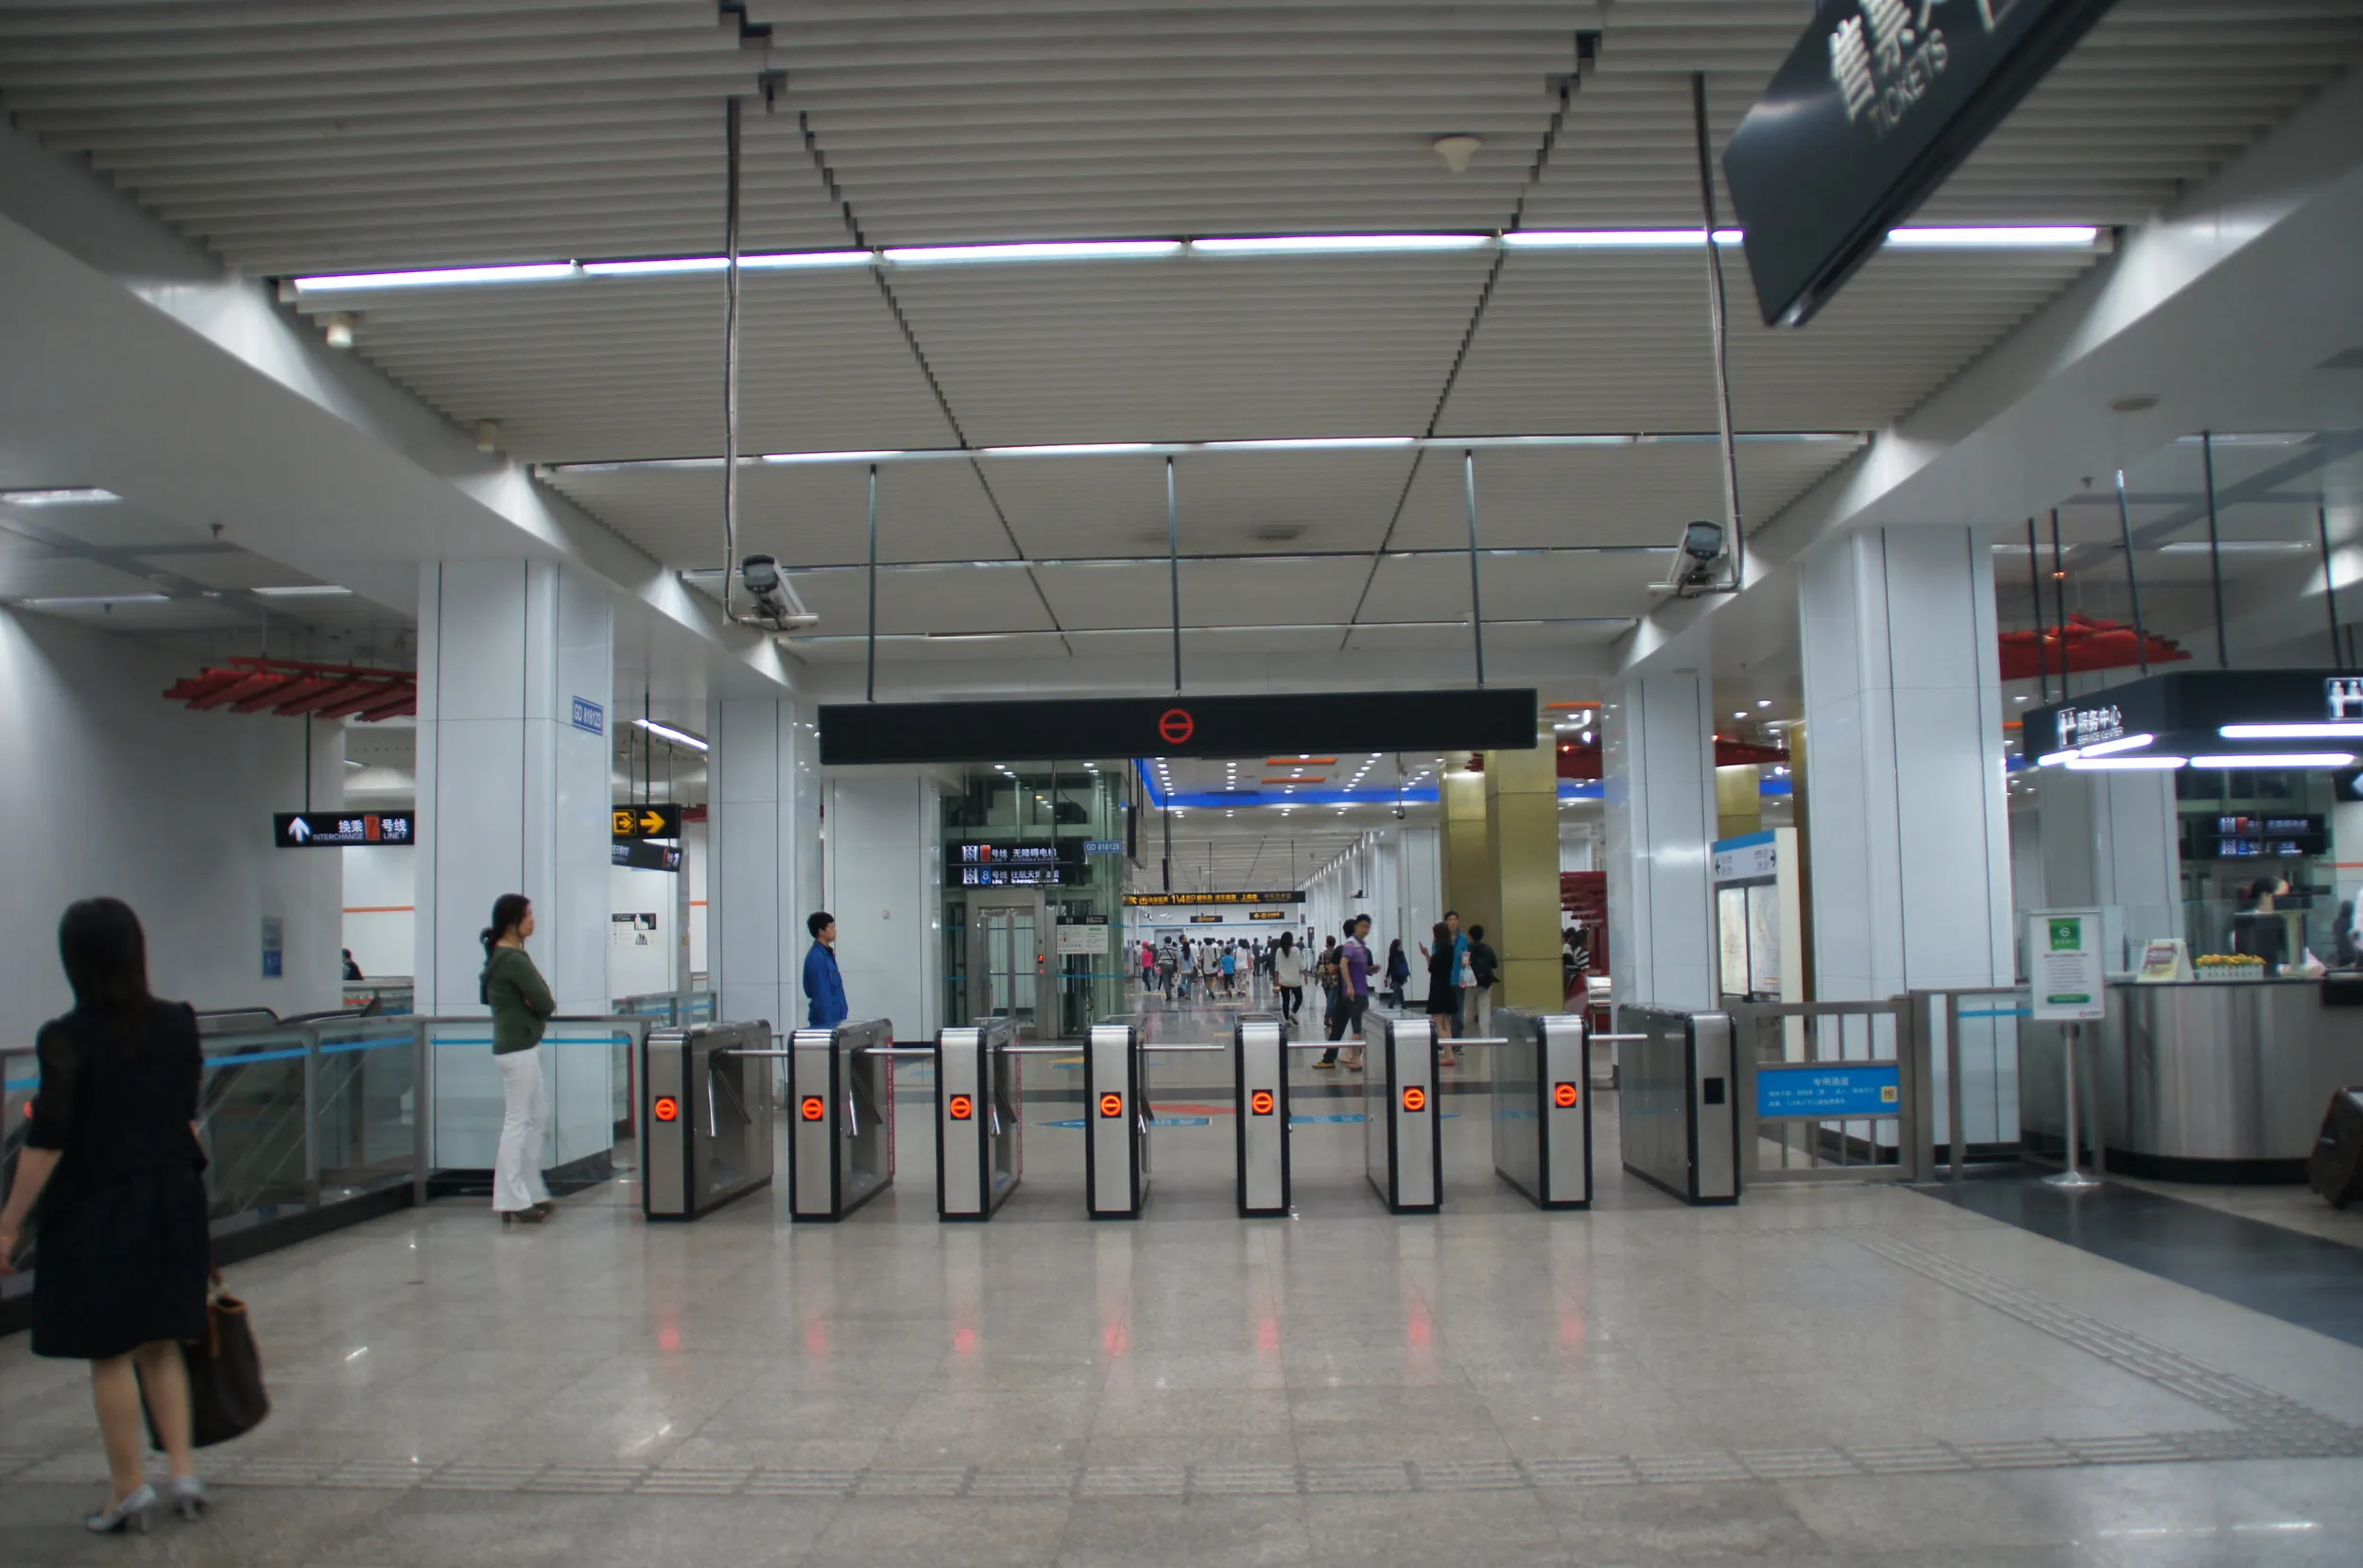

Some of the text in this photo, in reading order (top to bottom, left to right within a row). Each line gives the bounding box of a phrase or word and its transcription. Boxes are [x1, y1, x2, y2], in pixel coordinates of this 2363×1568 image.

[1868, 27, 1949, 140] TICKETS
[338, 819, 364, 833] 换乘
[381, 818, 407, 833] 号线
[982, 870, 990, 880] 8
